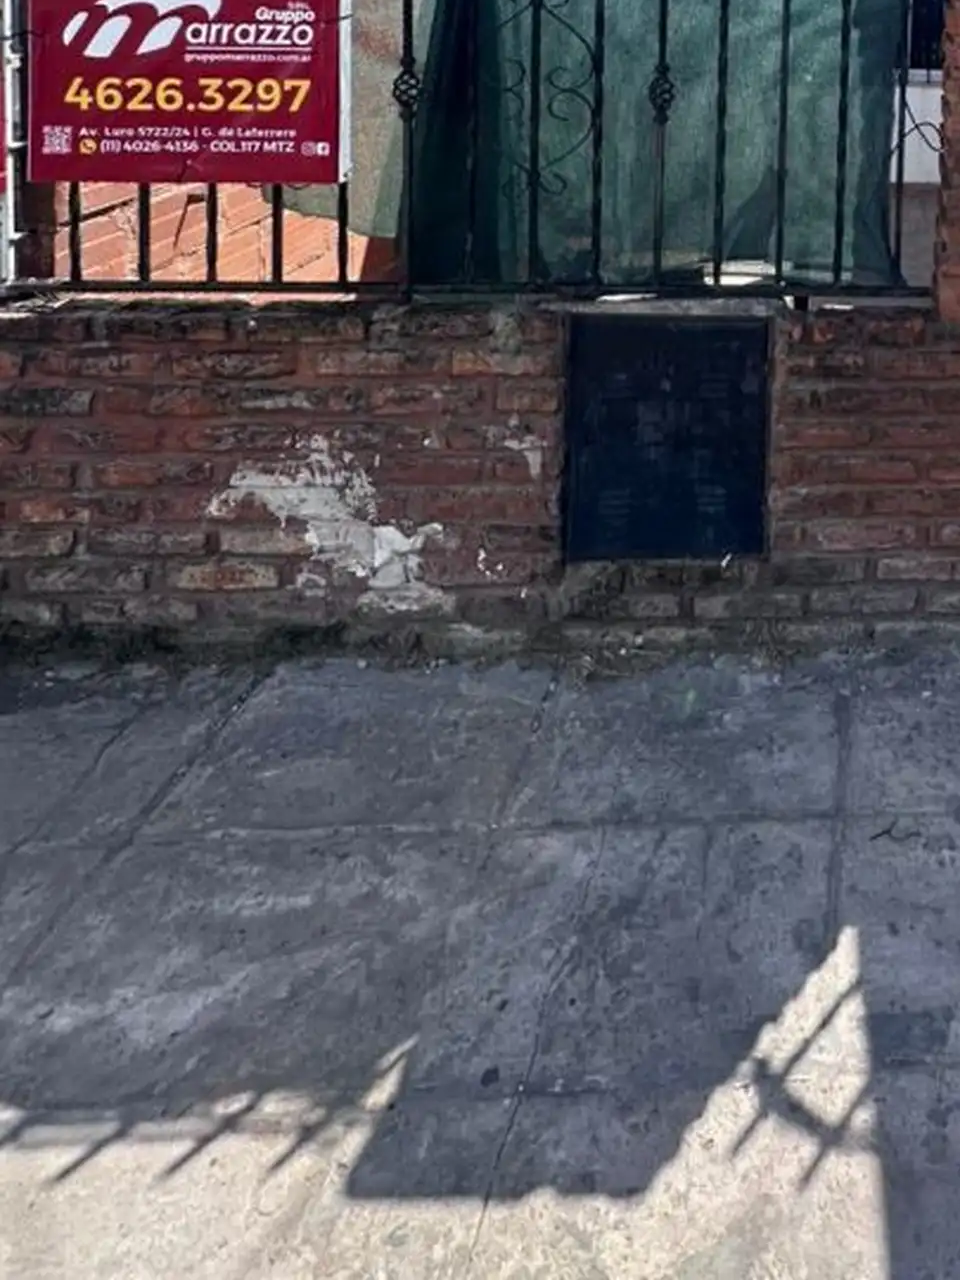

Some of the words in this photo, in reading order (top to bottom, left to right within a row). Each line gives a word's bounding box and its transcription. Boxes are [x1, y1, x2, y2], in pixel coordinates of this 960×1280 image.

[255, 6, 316, 23] Gruppo
[64, 77, 312, 113] 4626.3297
[262, 140, 296, 153] MTZ
